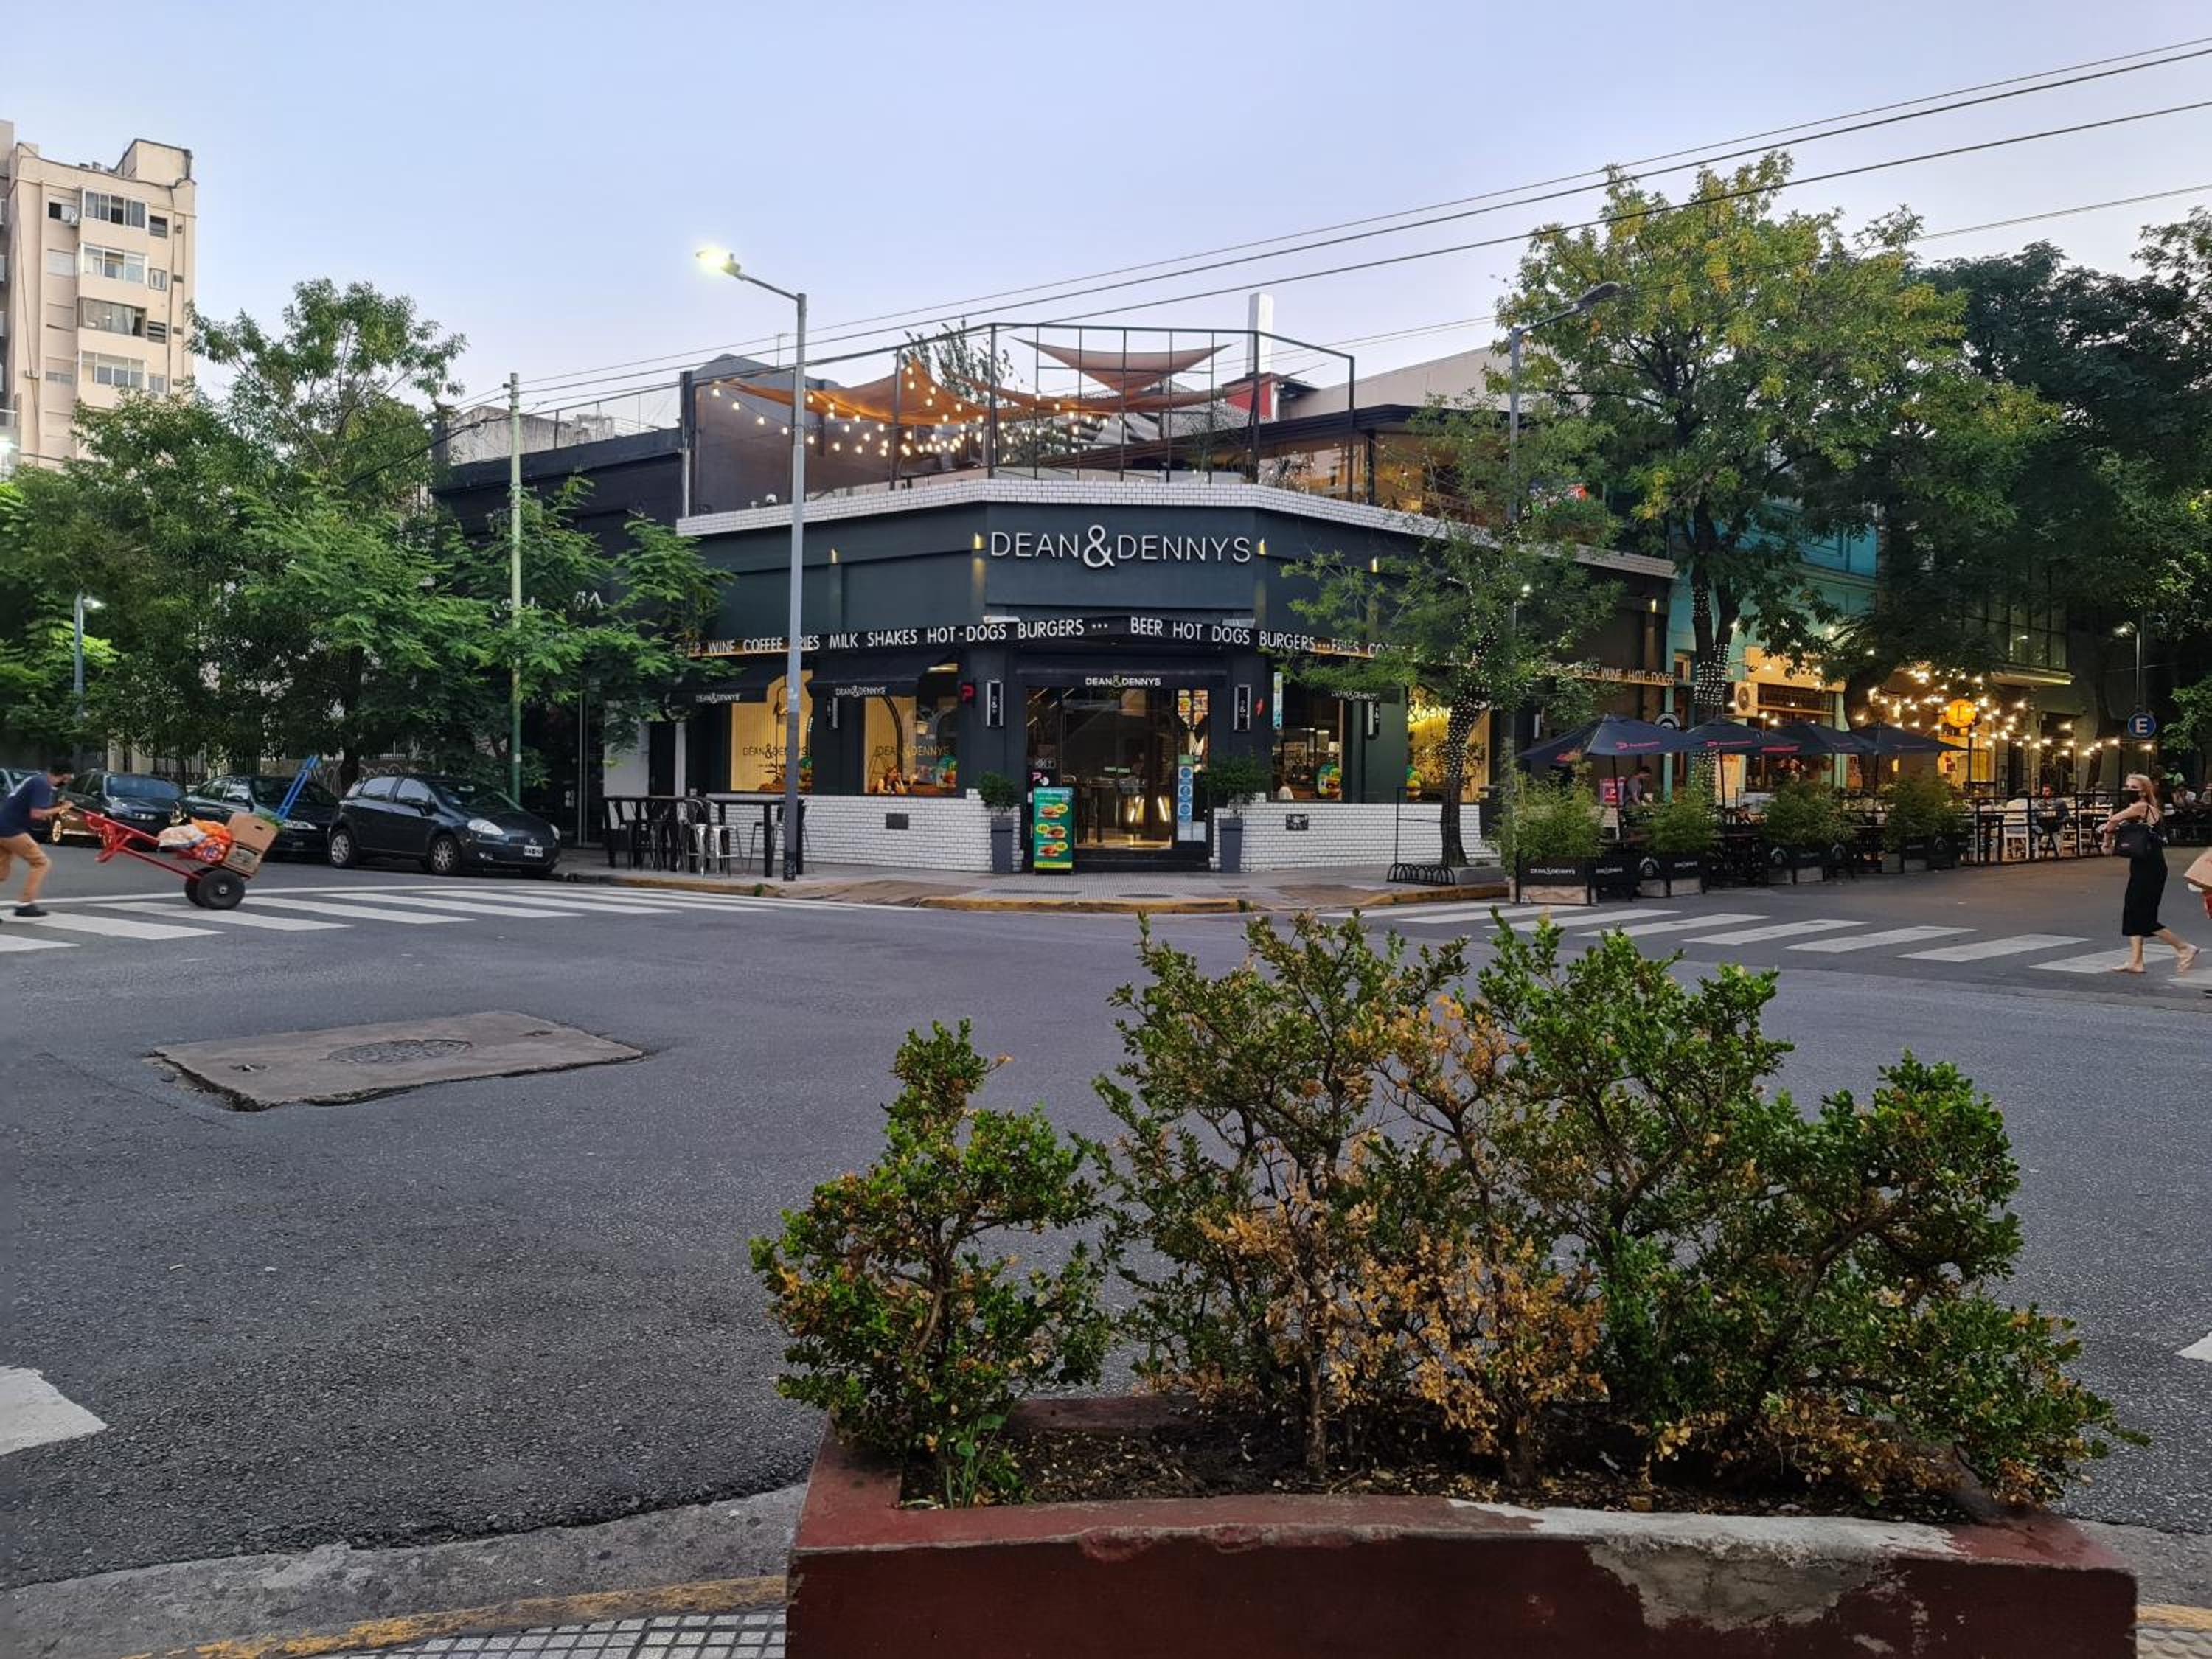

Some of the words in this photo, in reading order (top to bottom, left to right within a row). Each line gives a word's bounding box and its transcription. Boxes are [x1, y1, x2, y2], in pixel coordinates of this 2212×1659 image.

[829, 633, 859, 649] MILK
[867, 629, 918, 647] SHAKES
[1018, 619, 1085, 639] BURGERS
[1130, 617, 1163, 636] BEER
[1172, 621, 1203, 641] HOT
[1211, 626, 1251, 645] DOGS
[1259, 630, 1315, 651] BURGERS
[2136, 717, 2148, 733] E
